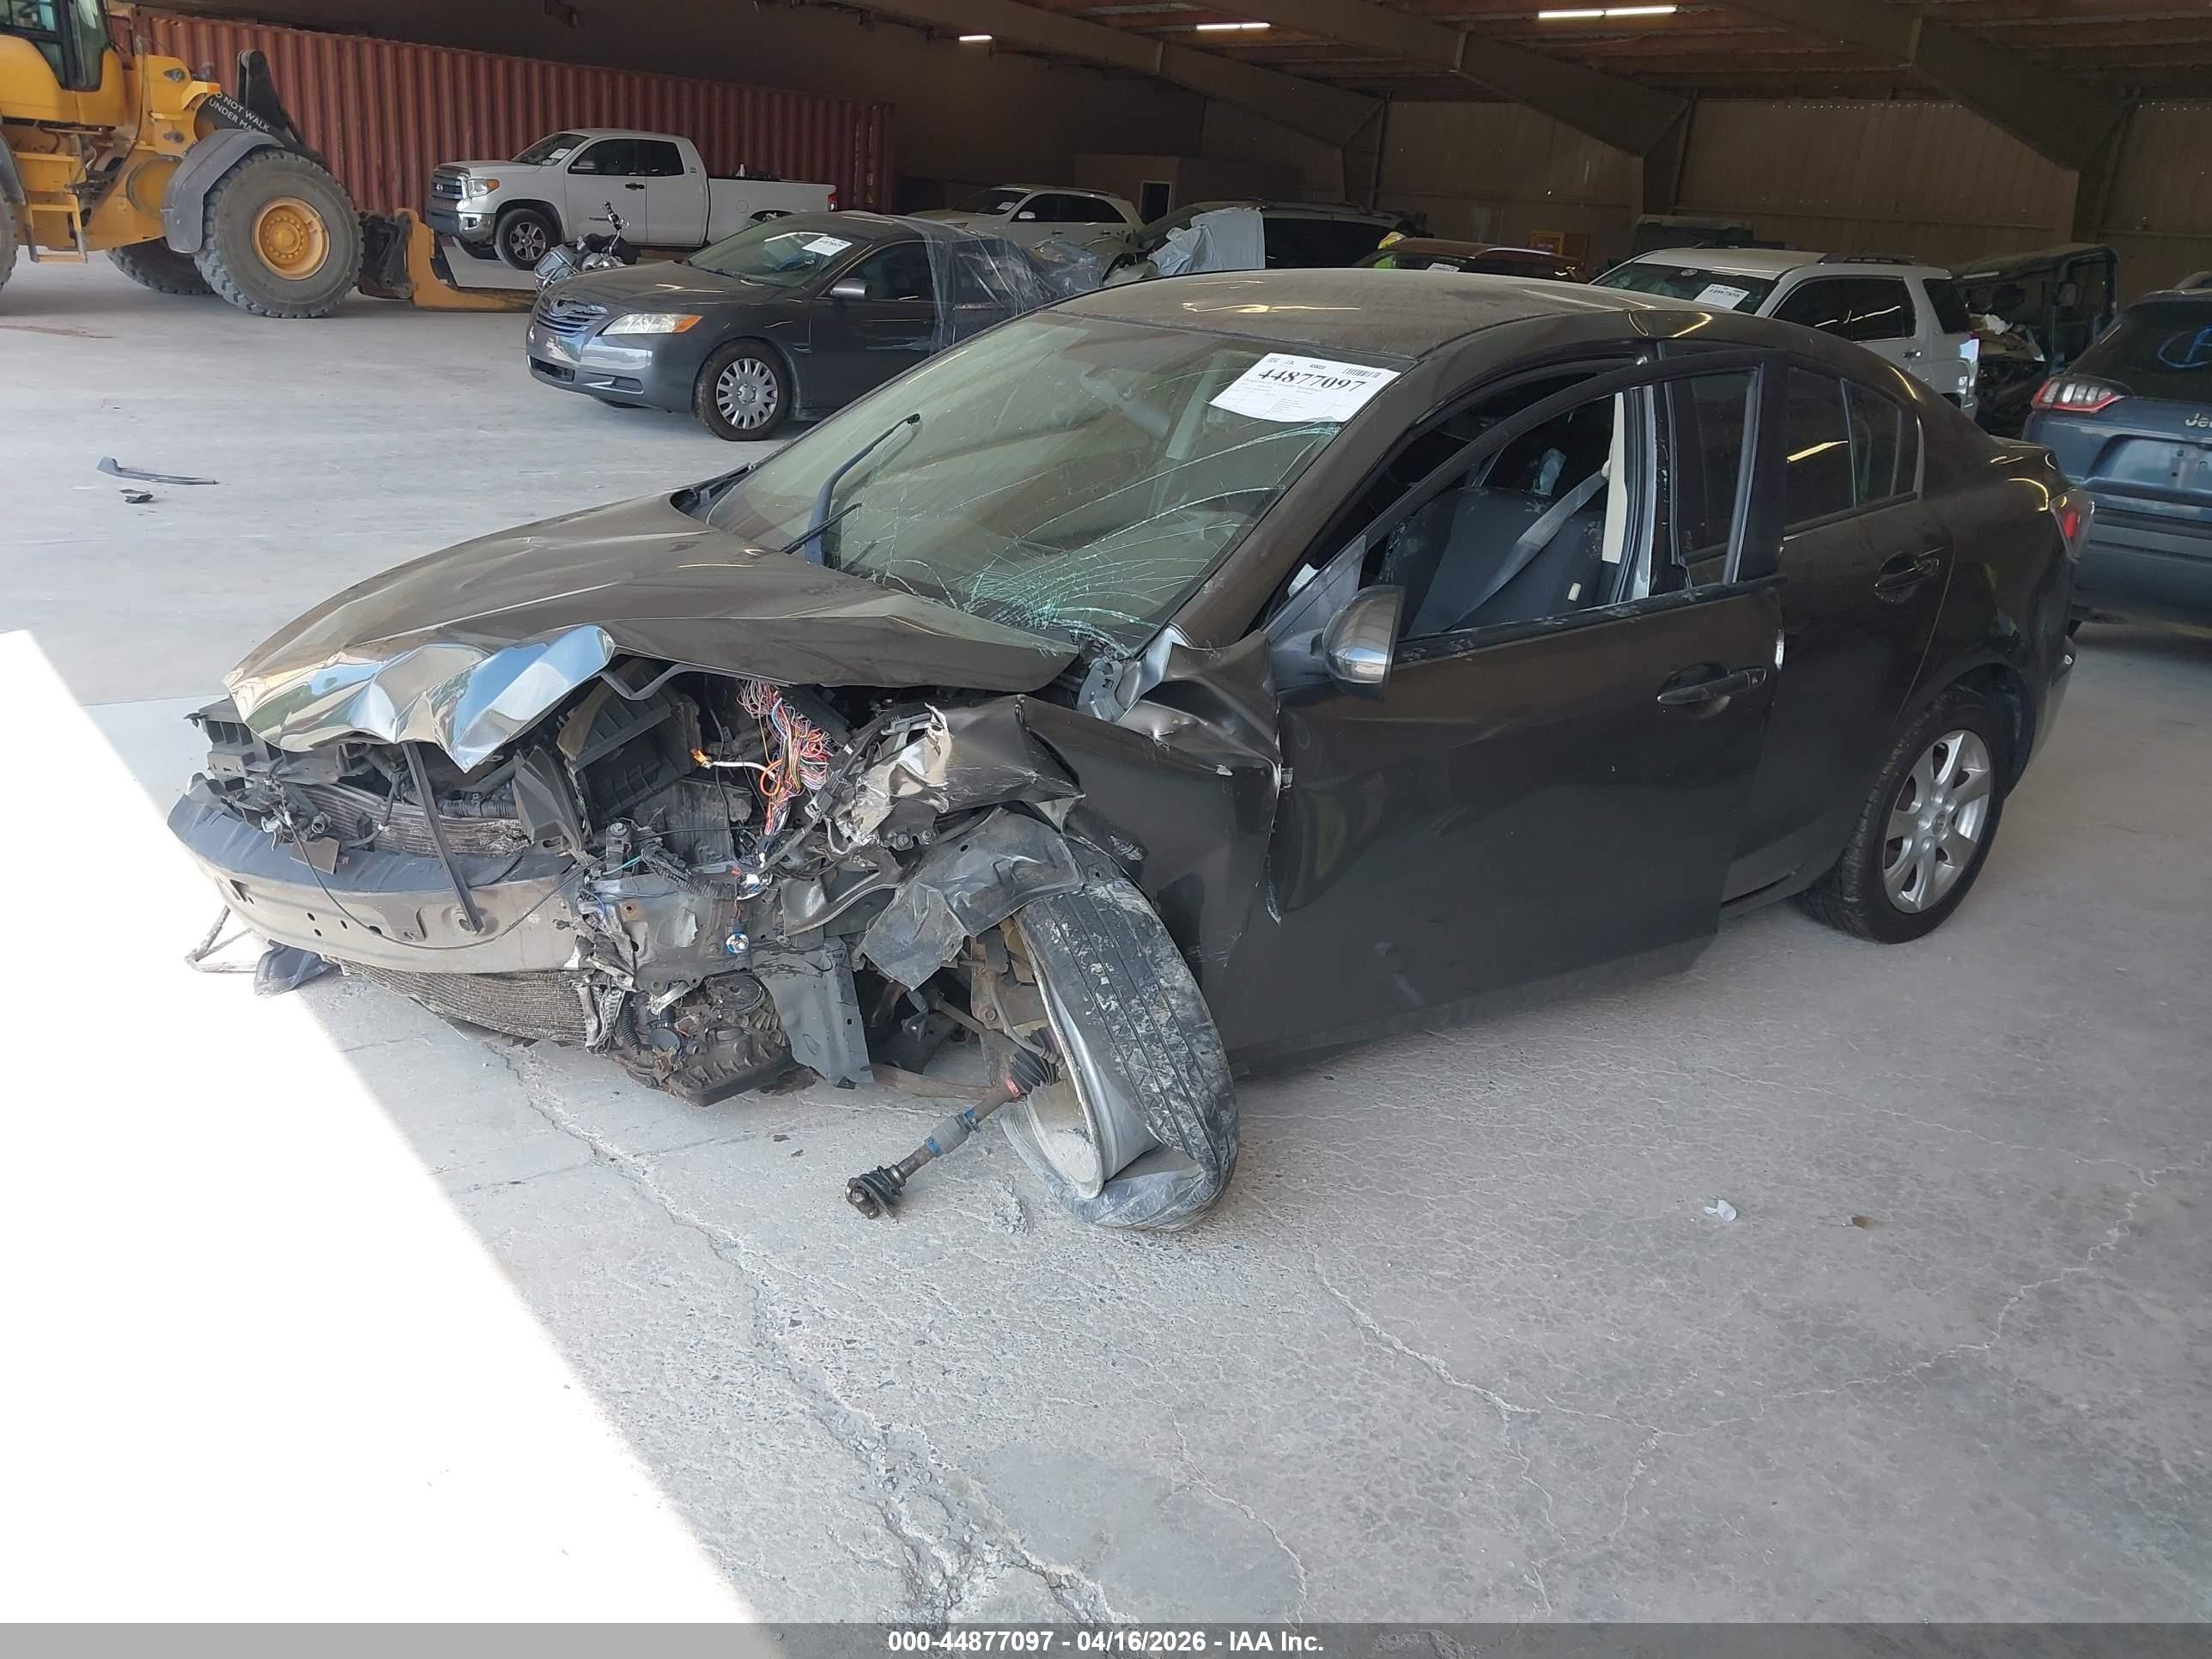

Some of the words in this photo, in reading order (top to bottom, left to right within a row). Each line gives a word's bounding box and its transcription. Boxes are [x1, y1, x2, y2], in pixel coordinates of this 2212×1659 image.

[209, 98, 239, 122] UNDER
[223, 97, 244, 112] NOT
[246, 111, 270, 132] WALK
[1258, 368, 1367, 392] 44877097
[2185, 412, 2212, 428] Je
